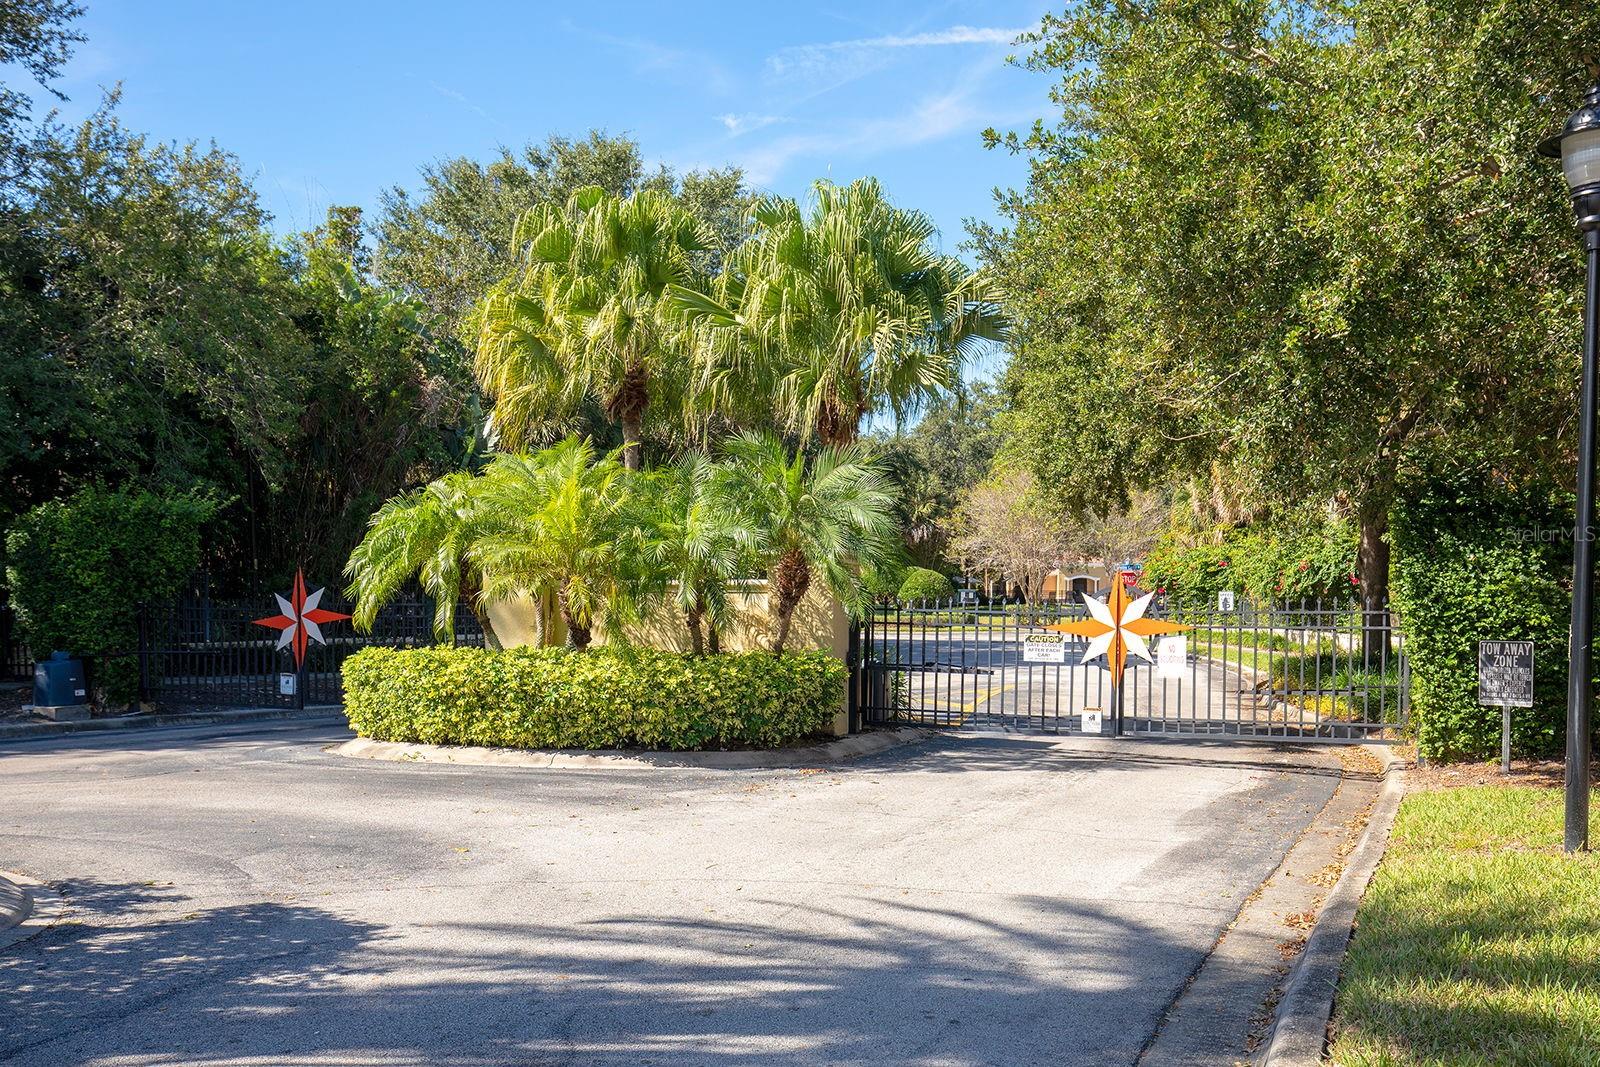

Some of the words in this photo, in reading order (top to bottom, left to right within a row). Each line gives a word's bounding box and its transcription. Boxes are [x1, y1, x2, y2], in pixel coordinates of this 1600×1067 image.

[1029, 635, 1059, 643] CAUTION
[1481, 642, 1501, 655] TOW
[1503, 643, 1531, 656] AWAY
[1493, 655, 1519, 668] ZONE
